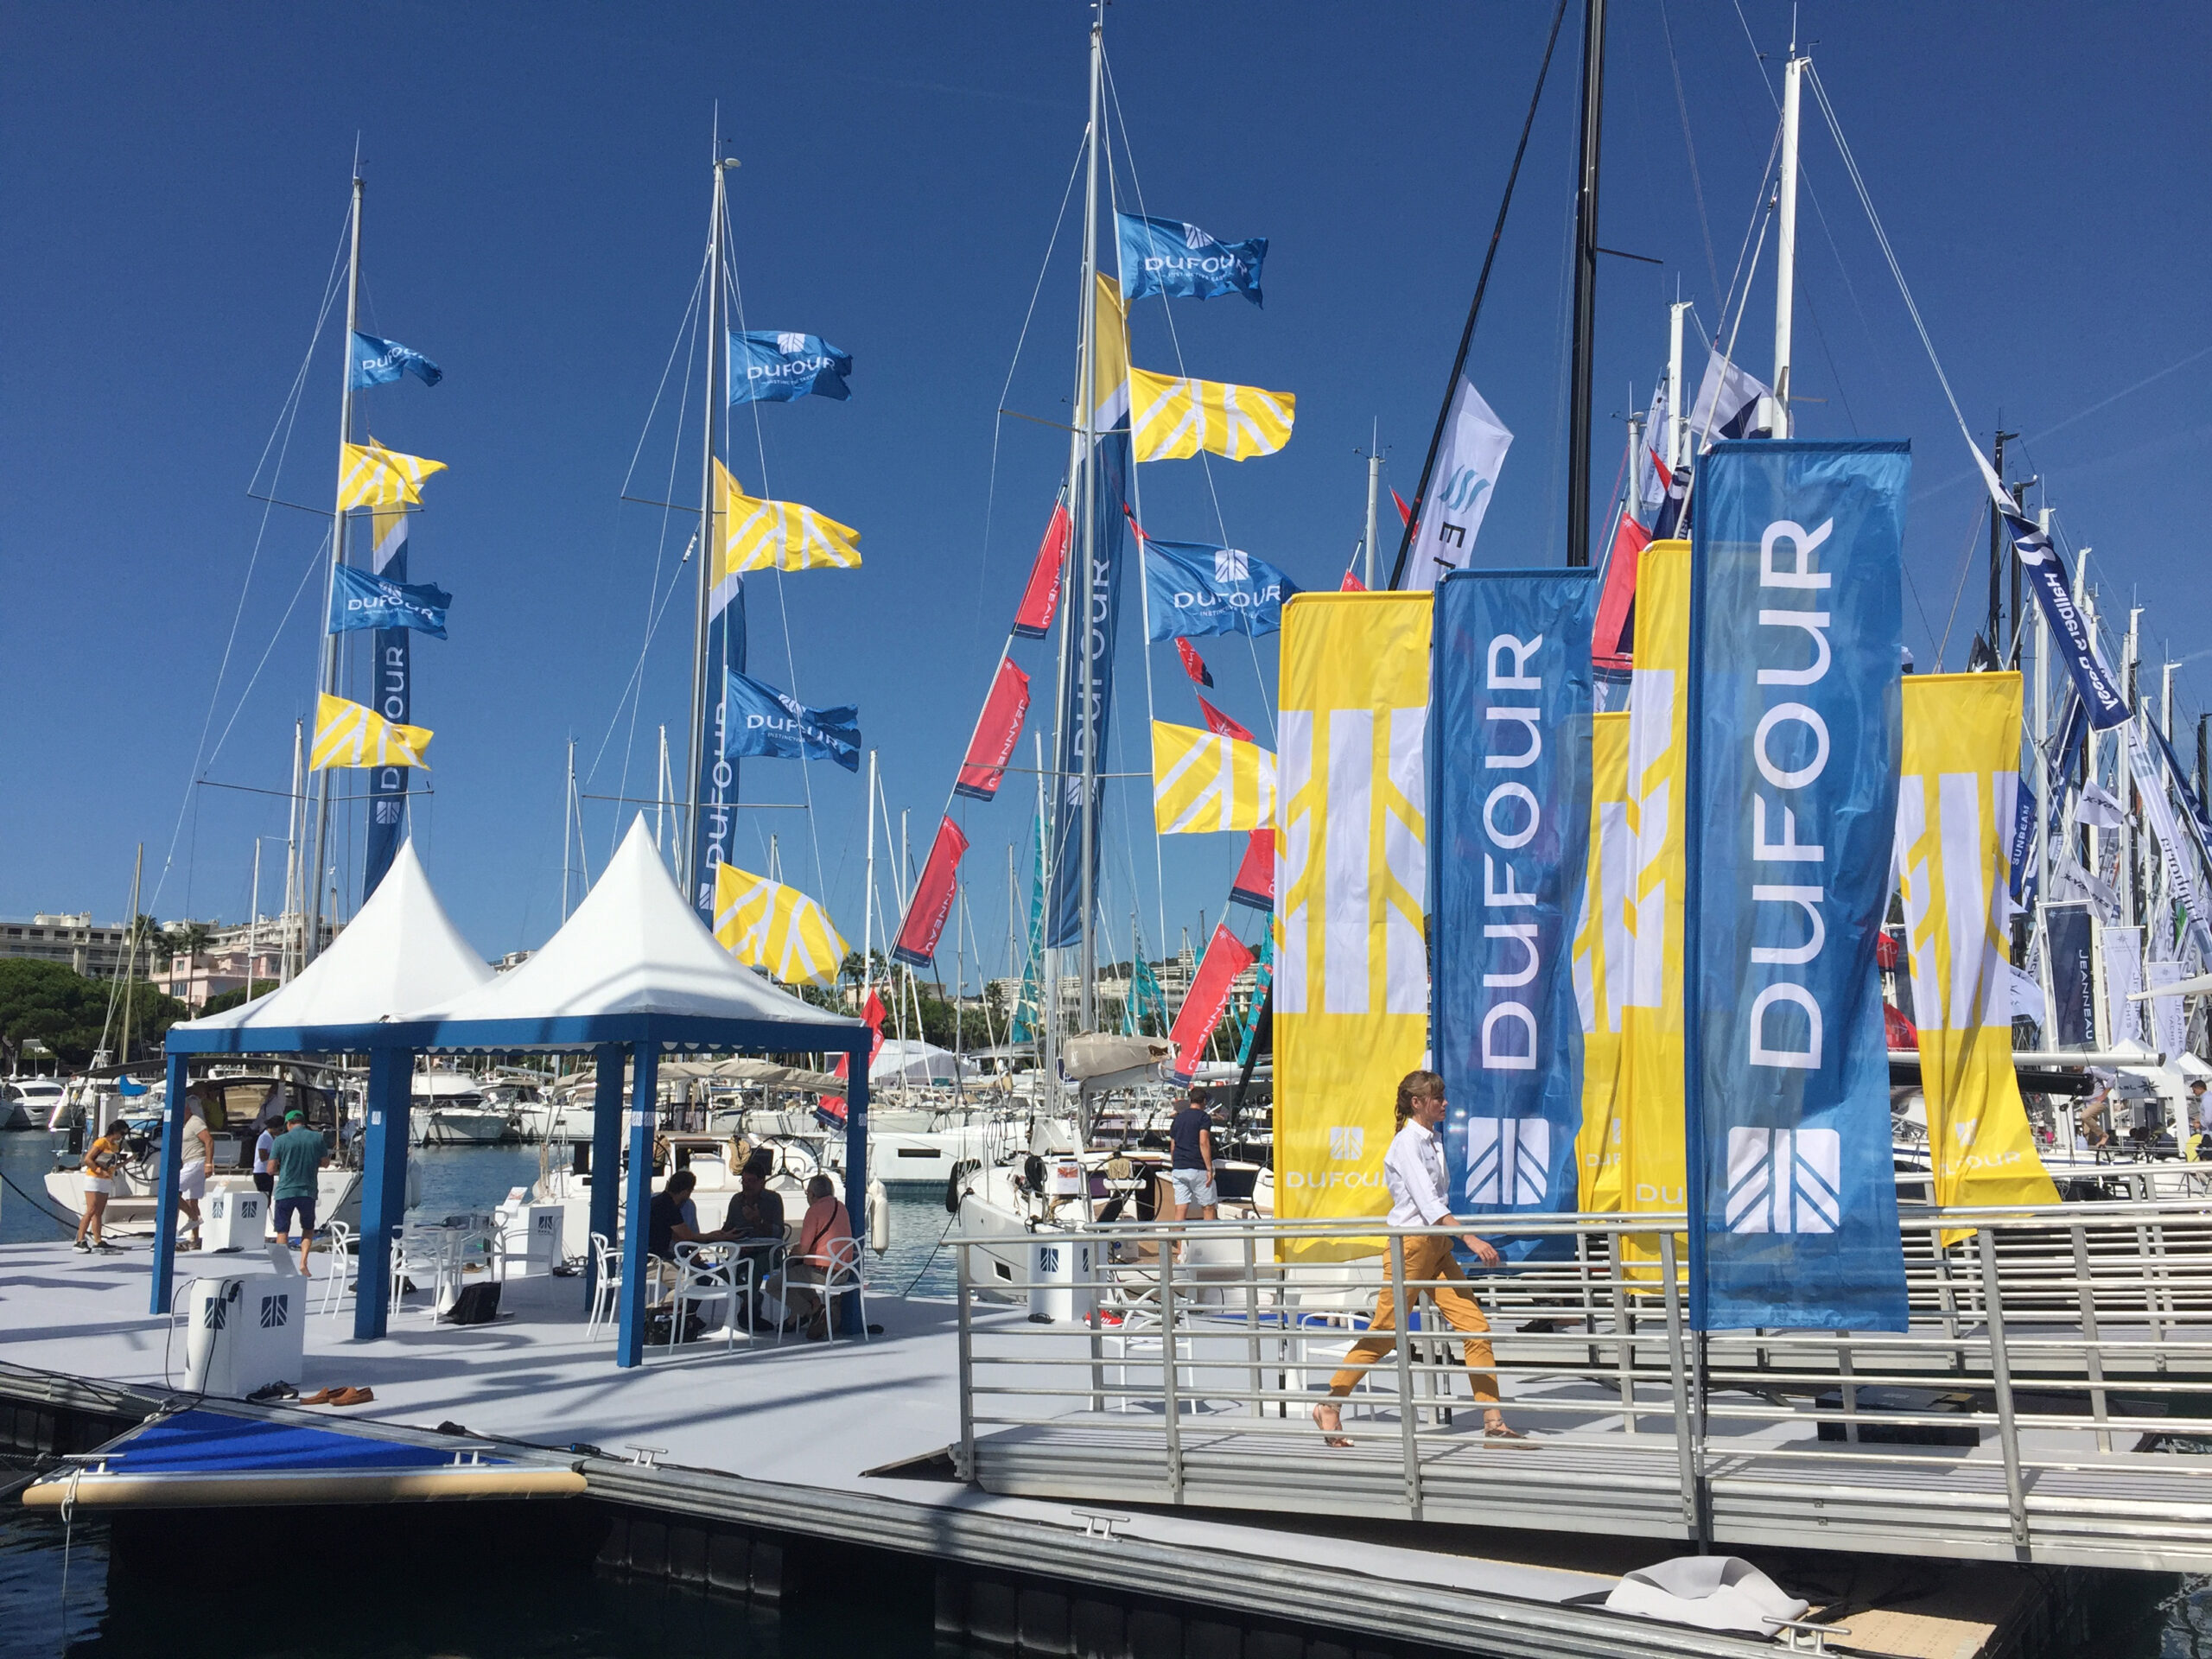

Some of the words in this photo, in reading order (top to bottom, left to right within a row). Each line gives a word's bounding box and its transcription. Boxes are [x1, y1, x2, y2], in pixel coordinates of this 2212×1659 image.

[1145, 254, 1248, 276] DUFOUR
[363, 346, 423, 371] DUFOU
[747, 357, 836, 380] DUFOUR
[381, 646, 404, 789] DOUR
[988, 699, 1027, 787] JEANNEAU
[1749, 516, 1834, 1069] DUFOUR
[1482, 633, 1543, 1070] DUFOUR
[2012, 805, 2031, 865] SUNBEAM
[925, 877, 956, 952] ANNEAU
[2079, 949, 2094, 1039] JEANNEAU
[2175, 999, 2183, 1054] JEANNEA
[1286, 1171, 1388, 1188] DUFOU
